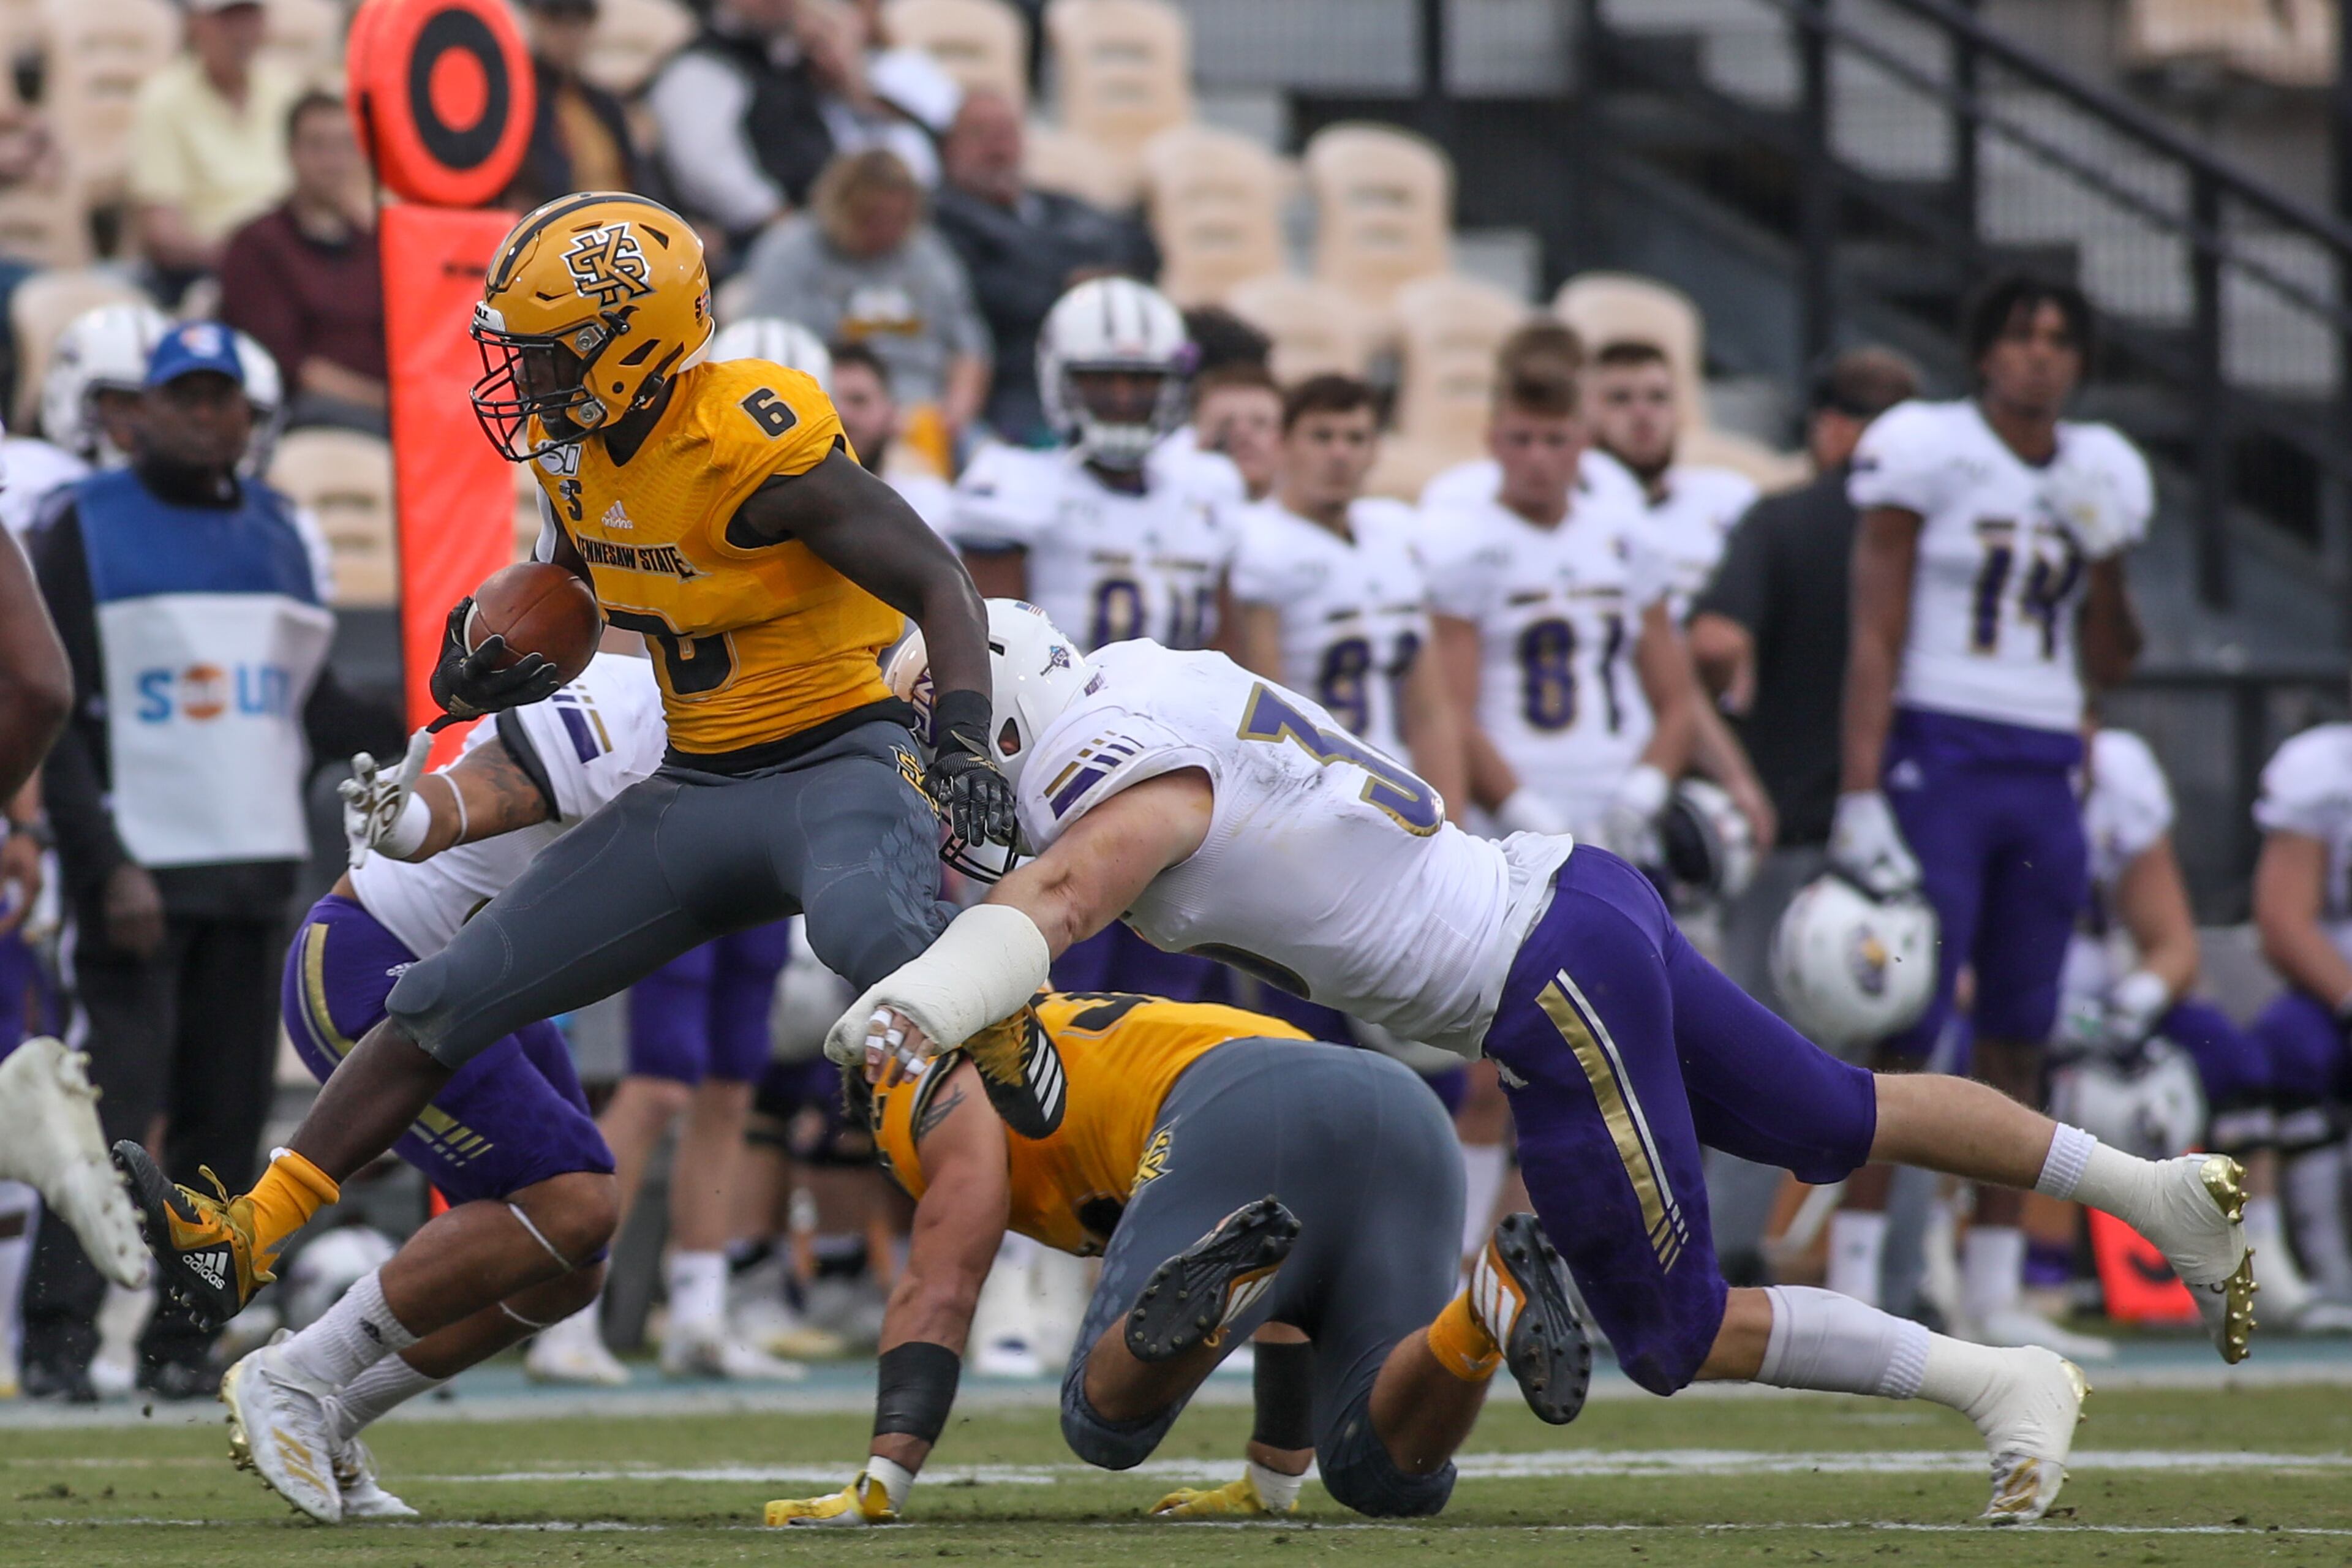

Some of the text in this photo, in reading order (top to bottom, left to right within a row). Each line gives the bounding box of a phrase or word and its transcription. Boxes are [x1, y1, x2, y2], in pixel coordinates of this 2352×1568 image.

[739, 387, 797, 437] 6
[601, 516, 634, 530] adidas
[638, 546, 696, 578] STATE
[182, 1253, 226, 1291] adidas
